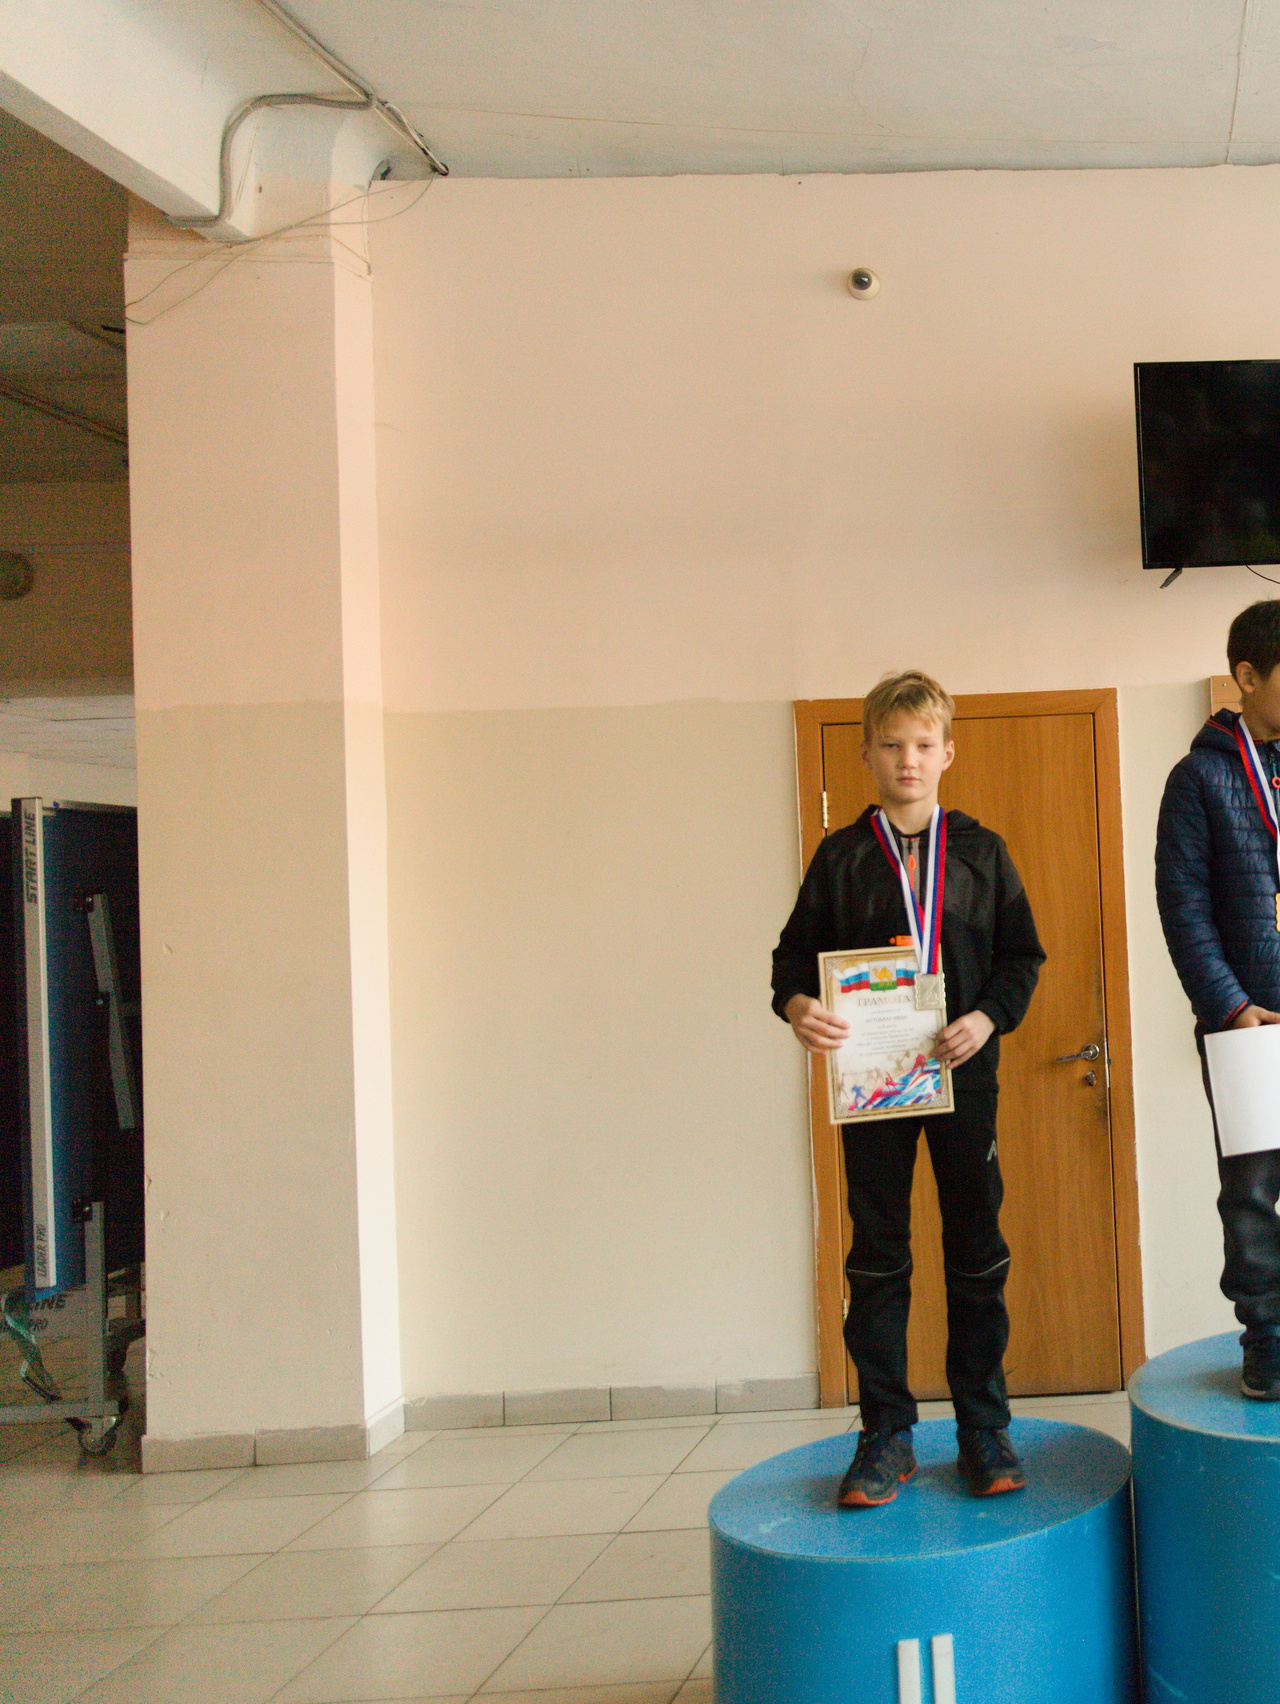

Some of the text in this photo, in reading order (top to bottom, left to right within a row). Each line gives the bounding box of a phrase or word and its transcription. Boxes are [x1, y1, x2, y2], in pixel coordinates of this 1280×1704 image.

[24, 808, 38, 904] START LINE
[857, 995, 911, 1007] ГРАМОТА
